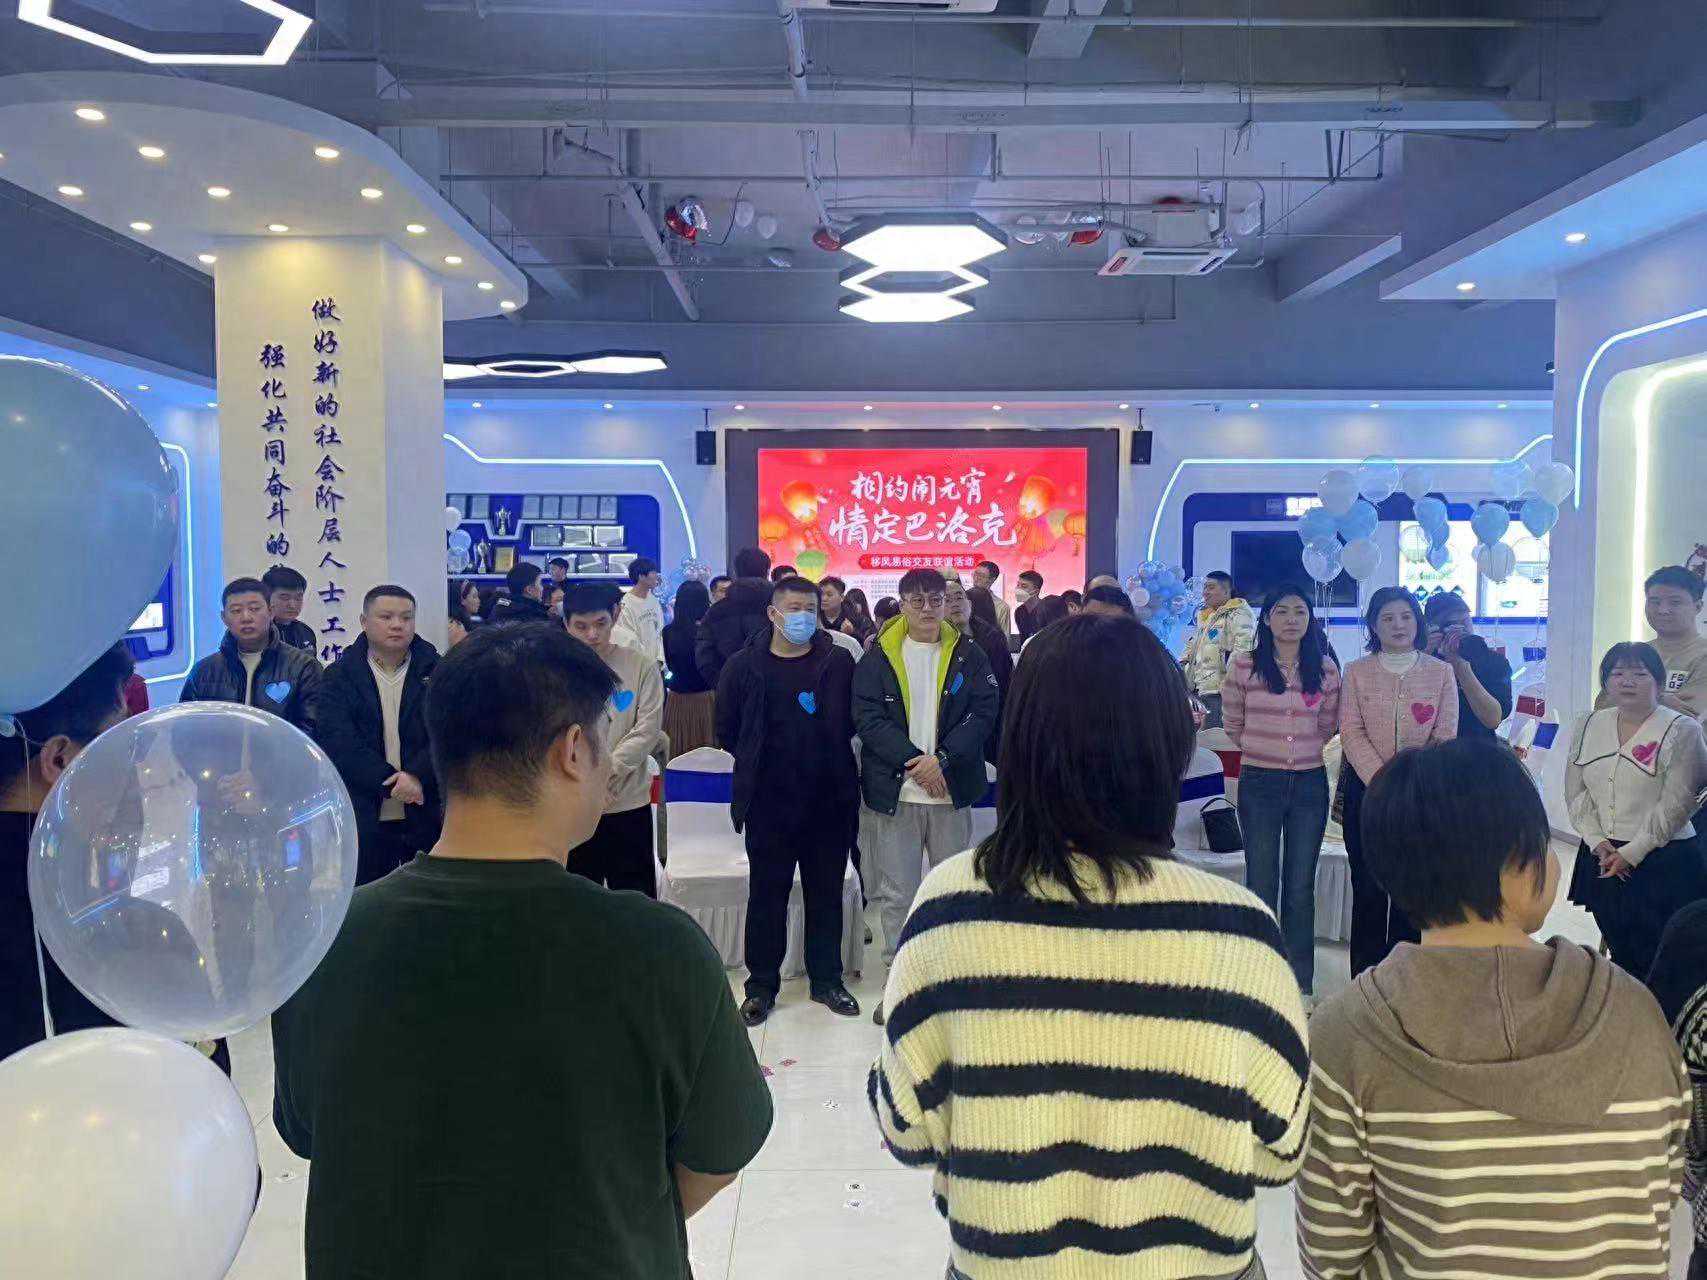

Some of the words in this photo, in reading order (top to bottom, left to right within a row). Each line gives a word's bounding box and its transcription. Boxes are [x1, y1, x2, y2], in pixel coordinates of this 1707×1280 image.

[260, 344, 291, 568] 强化共同奋斗的
[311, 297, 346, 661] 做好新的社会阶层人士工作
[850, 467, 987, 505] 相约闹元宵
[828, 504, 1017, 550] 情定巴洛克
